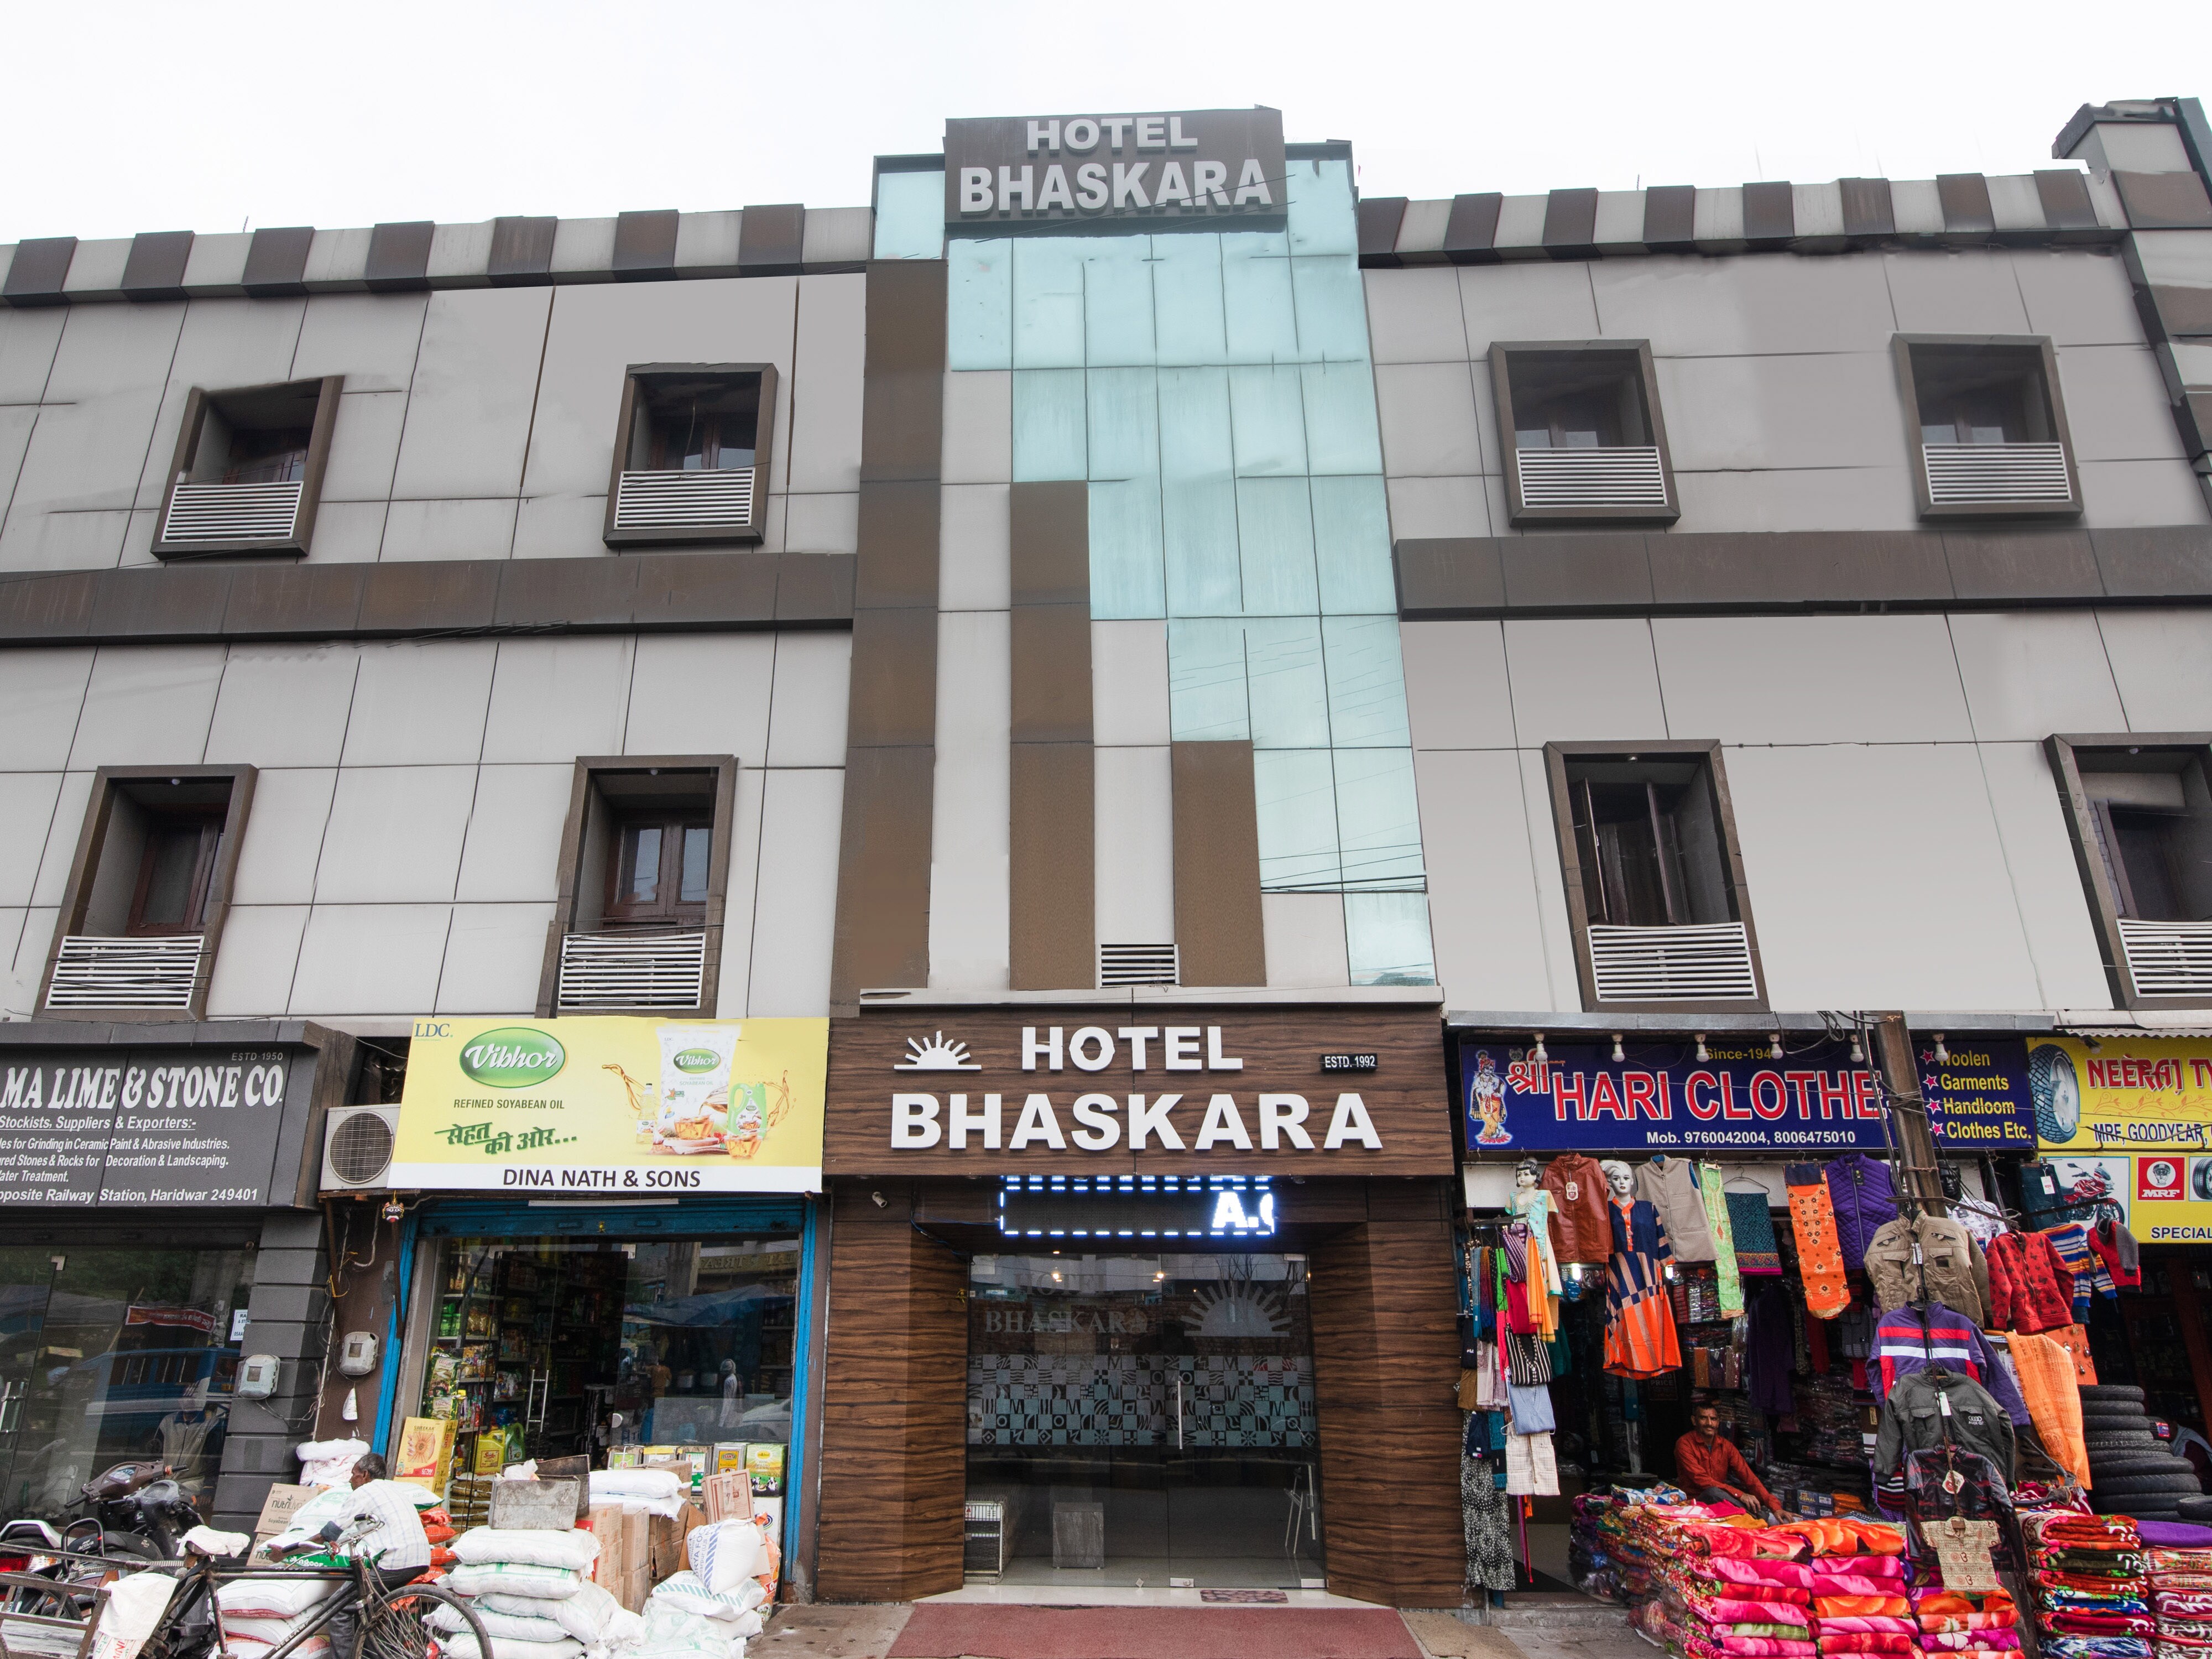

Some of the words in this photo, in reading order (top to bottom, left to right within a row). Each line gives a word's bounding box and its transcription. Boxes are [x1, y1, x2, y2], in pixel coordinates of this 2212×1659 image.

[1027, 116, 1198, 152] HOTEL
[960, 159, 1272, 214] BHASKARA
[465, 1043, 558, 1069] Vibhor
[1021, 1026, 1243, 1072] HOTEL
[1705, 1047, 1773, 1060] Since-194
[675, 1054, 717, 1066] Vibhor
[1324, 1055, 1353, 1068] ESTD.
[1354, 1055, 1376, 1068] 1992
[1940, 1073, 2010, 1091] Garments
[2086, 1057, 2184, 1093] NEERAJ
[0, 1067, 43, 1109] MA
[48, 1067, 121, 1109] LIME
[122, 1067, 147, 1109] &
[147, 1066, 242, 1108] STONE
[244, 1065, 283, 1107] CO.
[1552, 1070, 1673, 1121] HARI
[1684, 1070, 1893, 1121] CLOTHE
[453, 1099, 494, 1108] REFINED
[497, 1099, 547, 1109] SOYABEAN
[550, 1100, 565, 1109] OIL
[1943, 1097, 2016, 1115] Handloom
[0, 1115, 53, 1130] Stockists,
[55, 1115, 111, 1132] Suppliers
[114, 1115, 124, 1129] &
[890, 1093, 1384, 1150] BHASKARA
[1947, 1121, 2001, 1139] Clothes
[2004, 1121, 2032, 1139] Etc.
[434, 1121, 493, 1146] सेहत
[484, 1131, 513, 1155] की
[1646, 1131, 1682, 1144] Mob.
[1684, 1131, 1771, 1146] 9760042004,
[1774, 1130, 1856, 1144] 8006475010
[2127, 1123, 2208, 1146] GOODYEAR,
[13, 1137, 27, 1150] for
[27, 1137, 65, 1153] Grinding
[65, 1138, 73, 1150] in
[74, 1138, 109, 1150] Ceramic
[109, 1138, 132, 1150] Paint
[132, 1138, 140, 1150] &
[140, 1138, 181, 1150] Abrasive
[182, 1138, 230, 1150] Industries.
[17, 1154, 48, 1166] Stones
[48, 1154, 56, 1166] &
[56, 1154, 85, 1167] Rocks
[85, 1154, 101, 1167] for
[105, 1154, 157, 1167] Decoration
[158, 1154, 165, 1167] &
[166, 1154, 229, 1169] Landscaping.
[21, 1170, 69, 1182] Treatment.
[503, 1168, 555, 1187] DINA
[561, 1170, 617, 1187] NATH
[623, 1170, 639, 1188] &
[645, 1170, 701, 1188] SONS
[45, 1188, 95, 1204] Railway
[99, 1188, 147, 1203] Station,
[150, 1188, 208, 1201] Haridwar
[210, 1188, 258, 1201] 249401
[2141, 1189, 2180, 1198] MRF
[2151, 1226, 2212, 1239] SPECIAL
[984, 1309, 1148, 1335] BHASKARA
